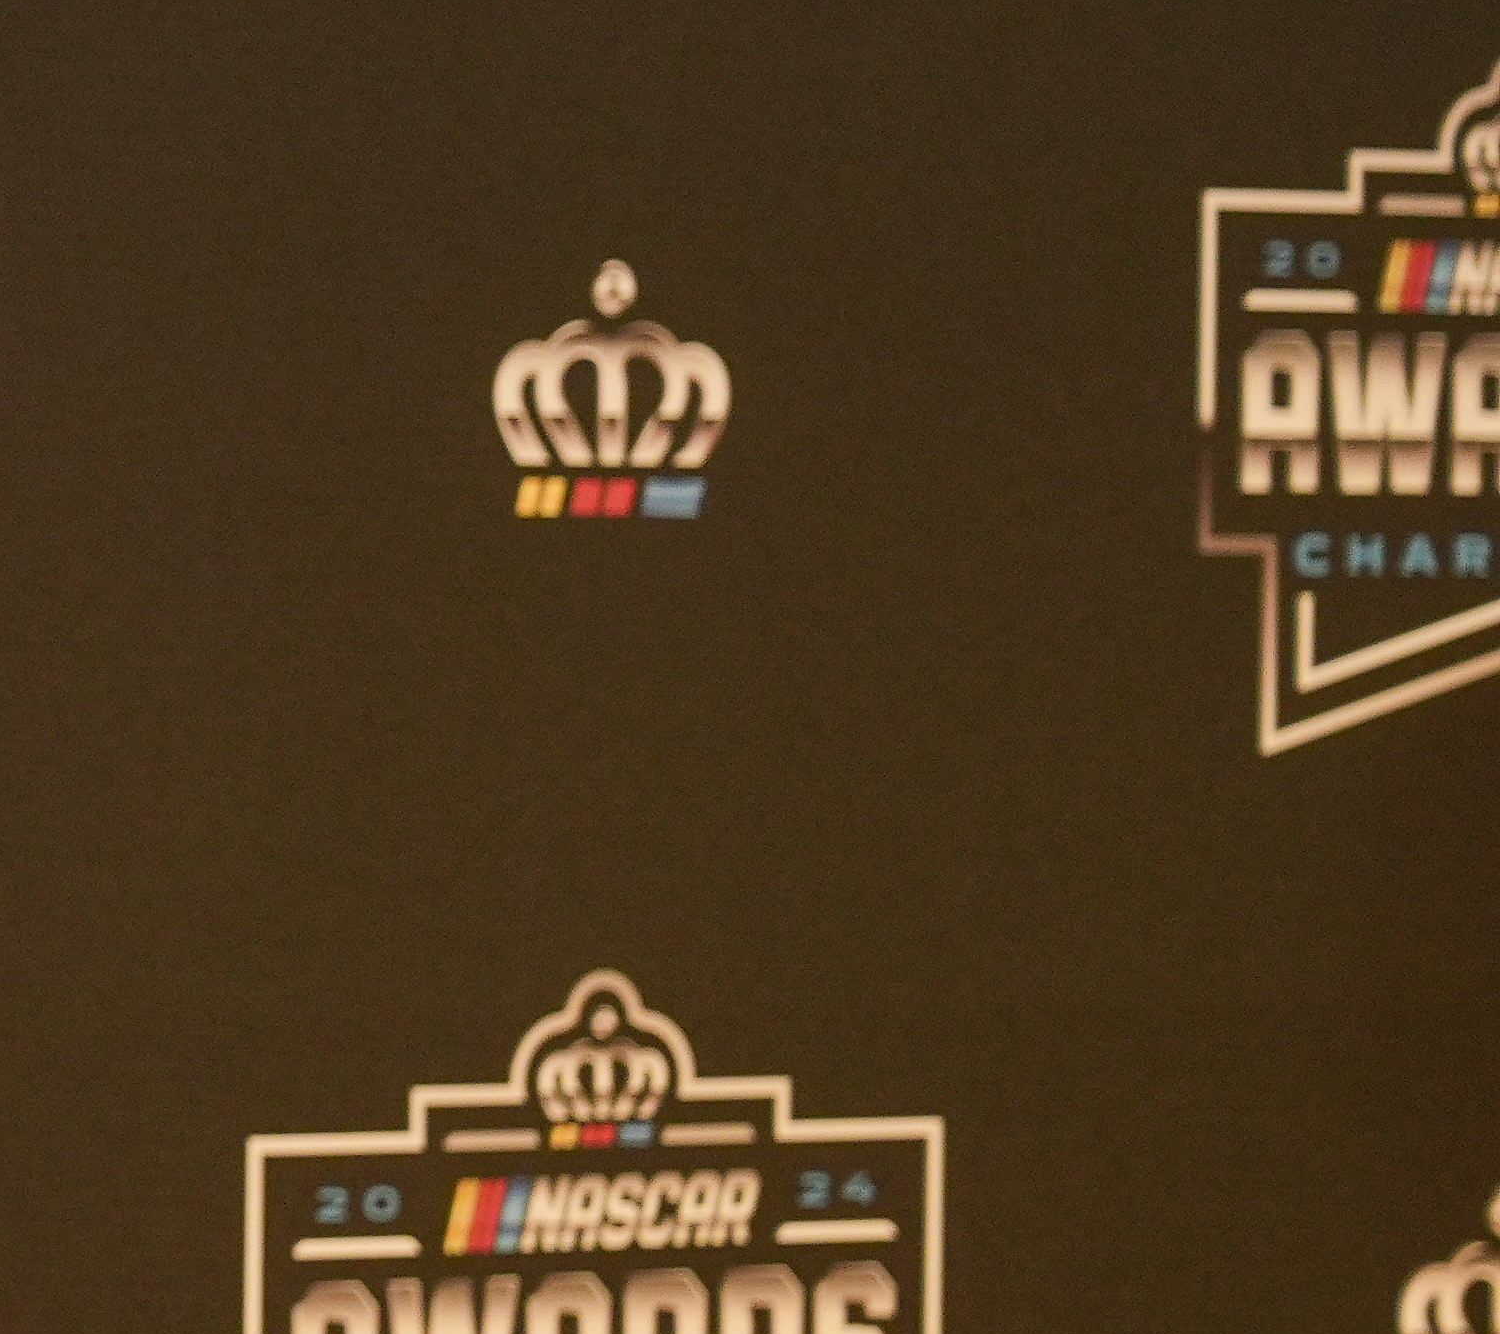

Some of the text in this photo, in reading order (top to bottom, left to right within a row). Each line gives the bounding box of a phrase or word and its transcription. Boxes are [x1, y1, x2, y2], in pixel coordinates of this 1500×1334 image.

[315, 1167, 879, 1255] 20 NASCAR 24
